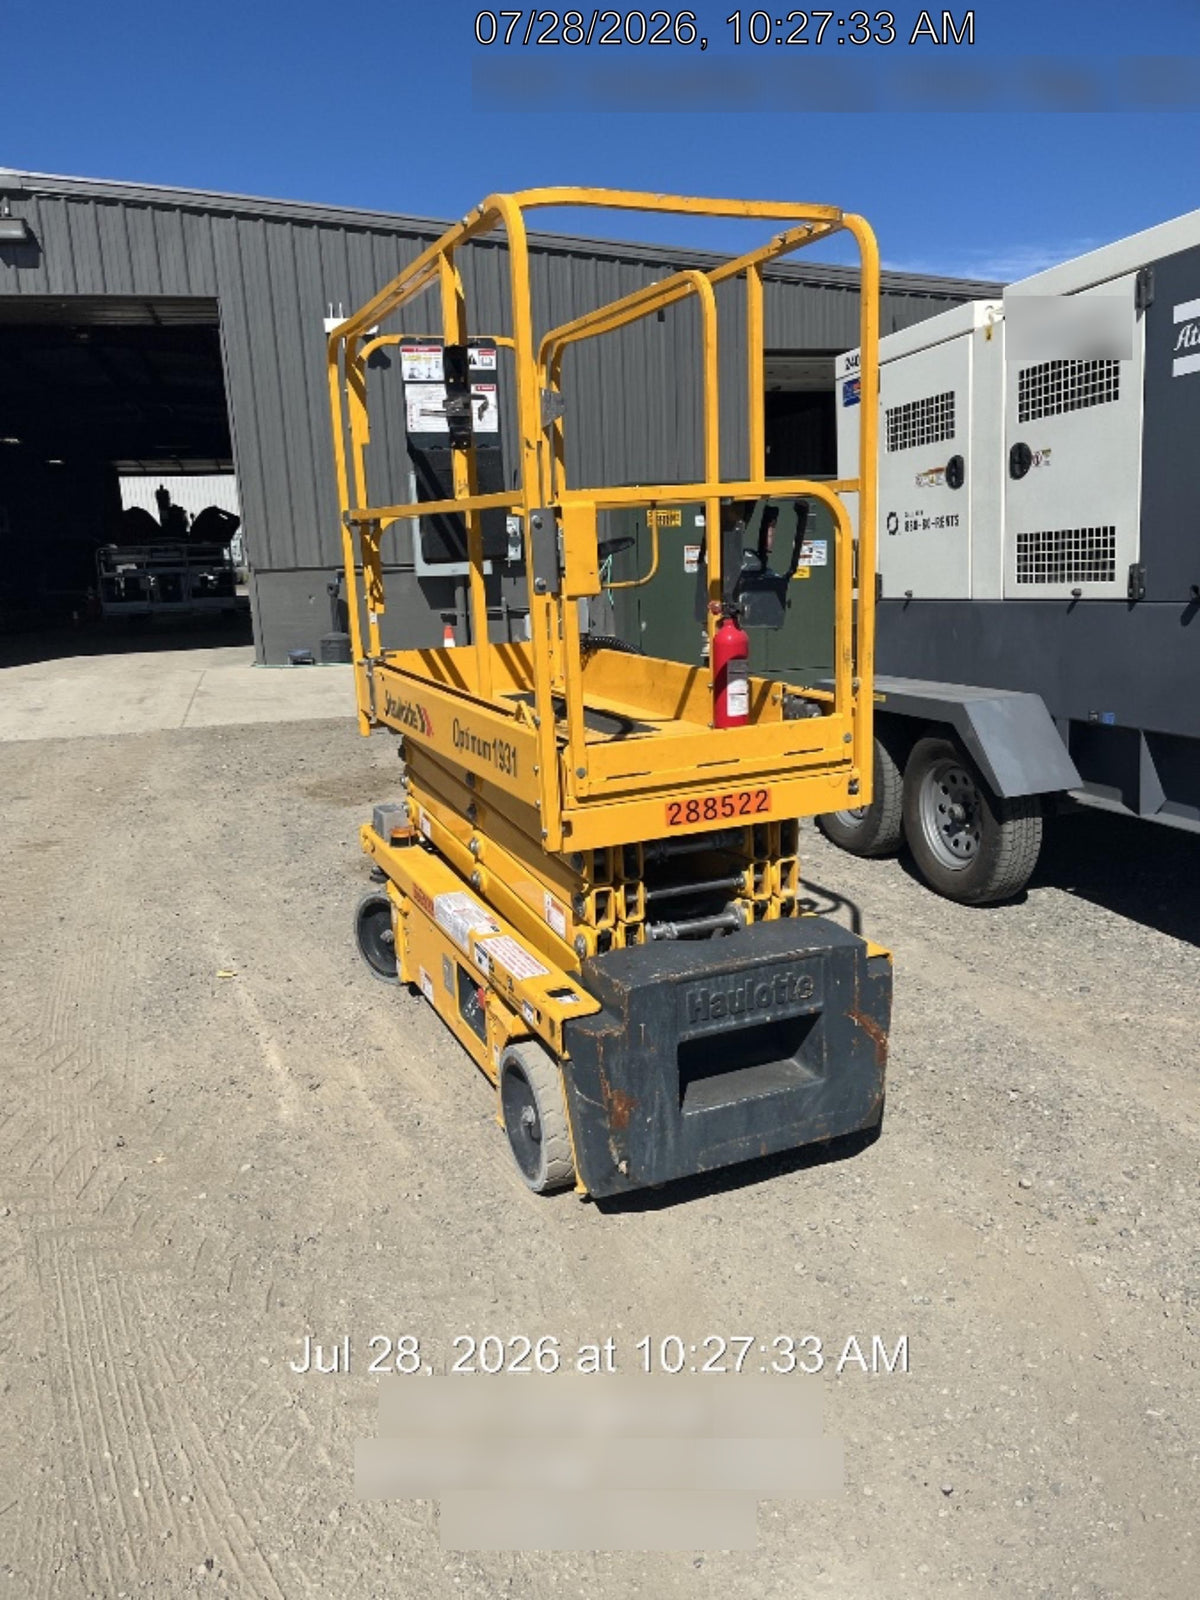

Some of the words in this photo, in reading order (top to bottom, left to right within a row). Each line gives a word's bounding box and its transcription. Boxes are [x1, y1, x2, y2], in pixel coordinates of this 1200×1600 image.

[1173, 323, 1200, 351] At
[668, 789, 769, 826] 288522
[686, 971, 815, 1023] Haulotte
